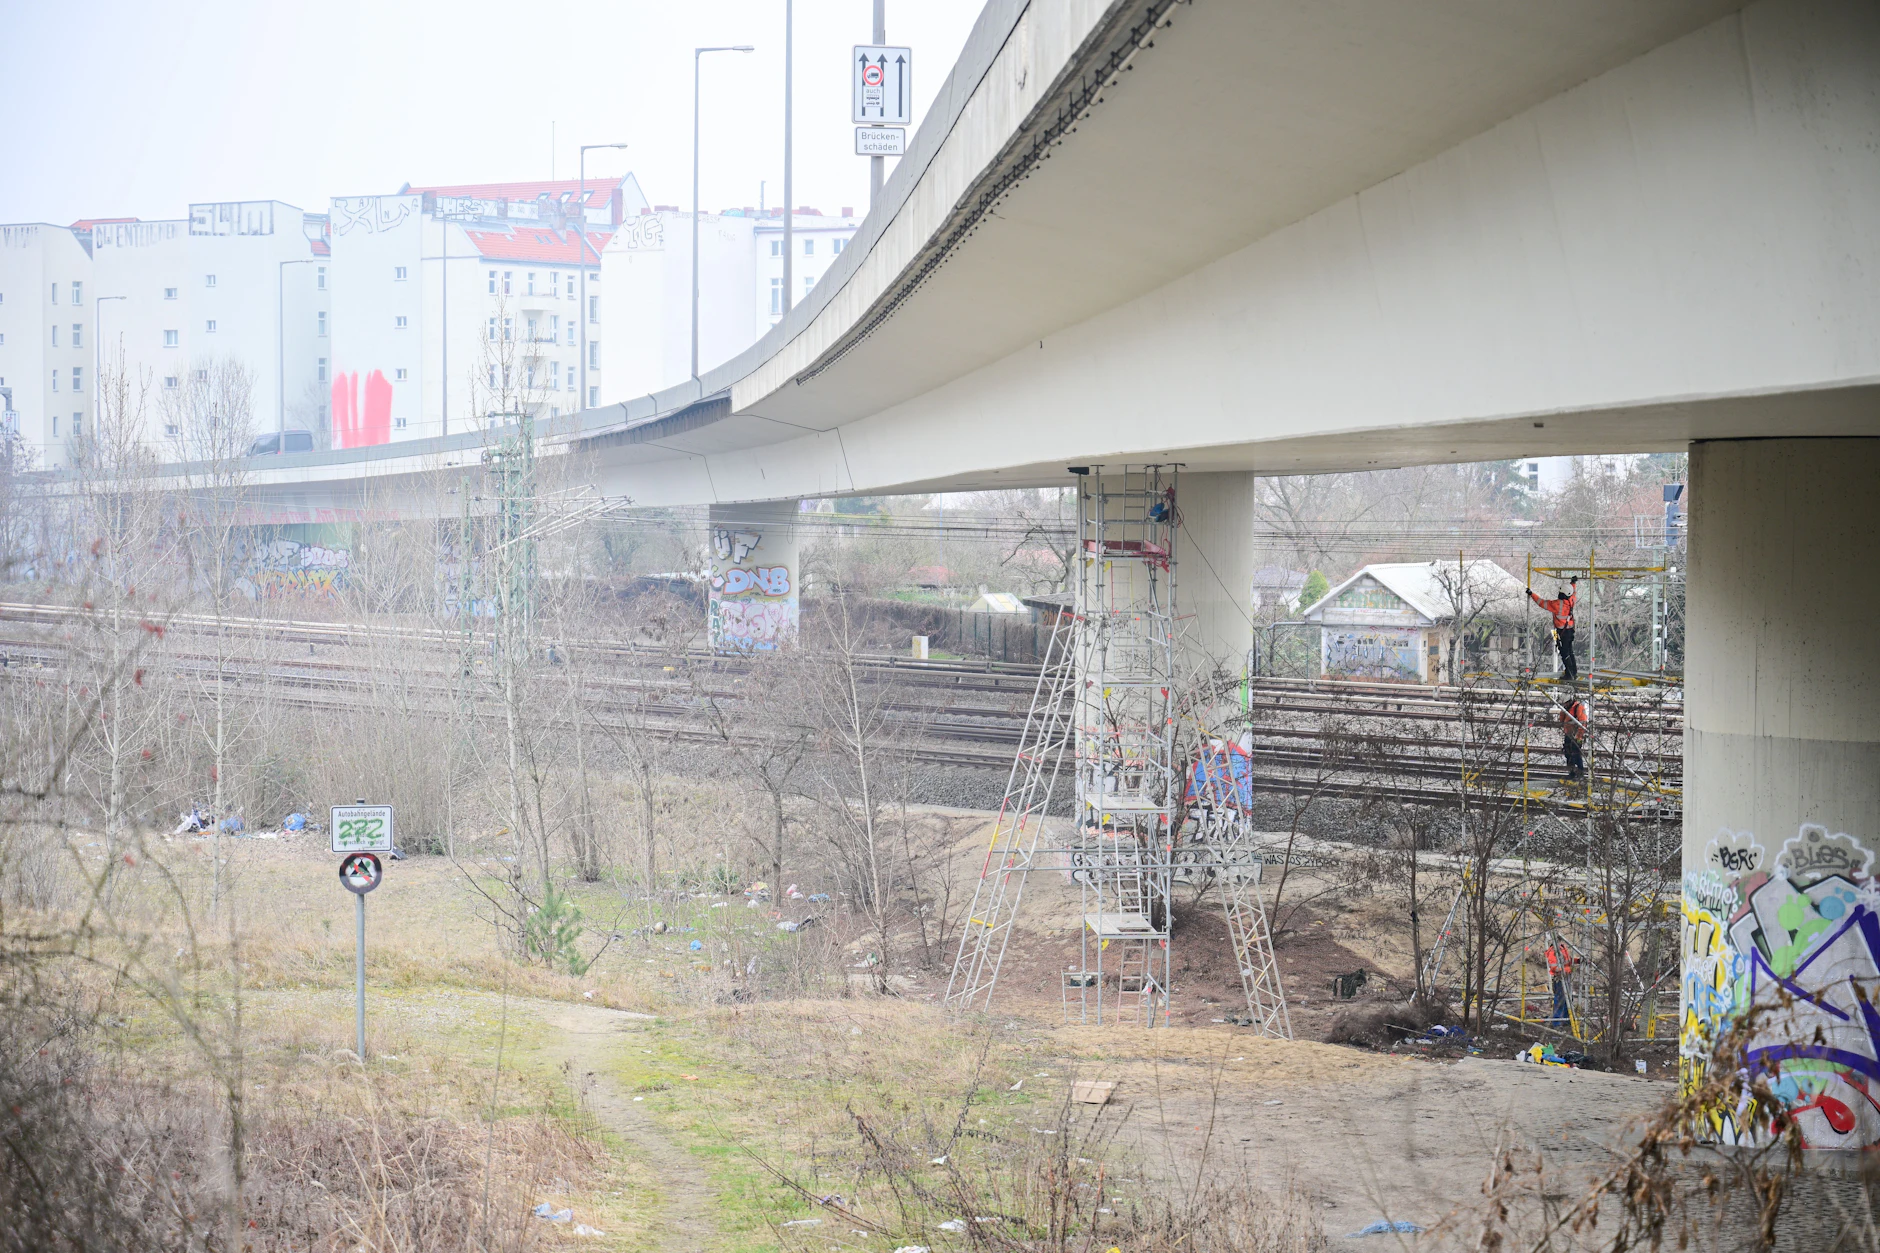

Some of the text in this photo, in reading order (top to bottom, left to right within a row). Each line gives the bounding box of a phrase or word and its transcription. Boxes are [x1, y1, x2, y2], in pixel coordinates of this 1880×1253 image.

[861, 132, 899, 140] Brücken-
[863, 142, 898, 151] schäden
[723, 566, 791, 596] DNB
[338, 810, 386, 818] Autobahngelände
[1263, 855, 1284, 865] WAS
